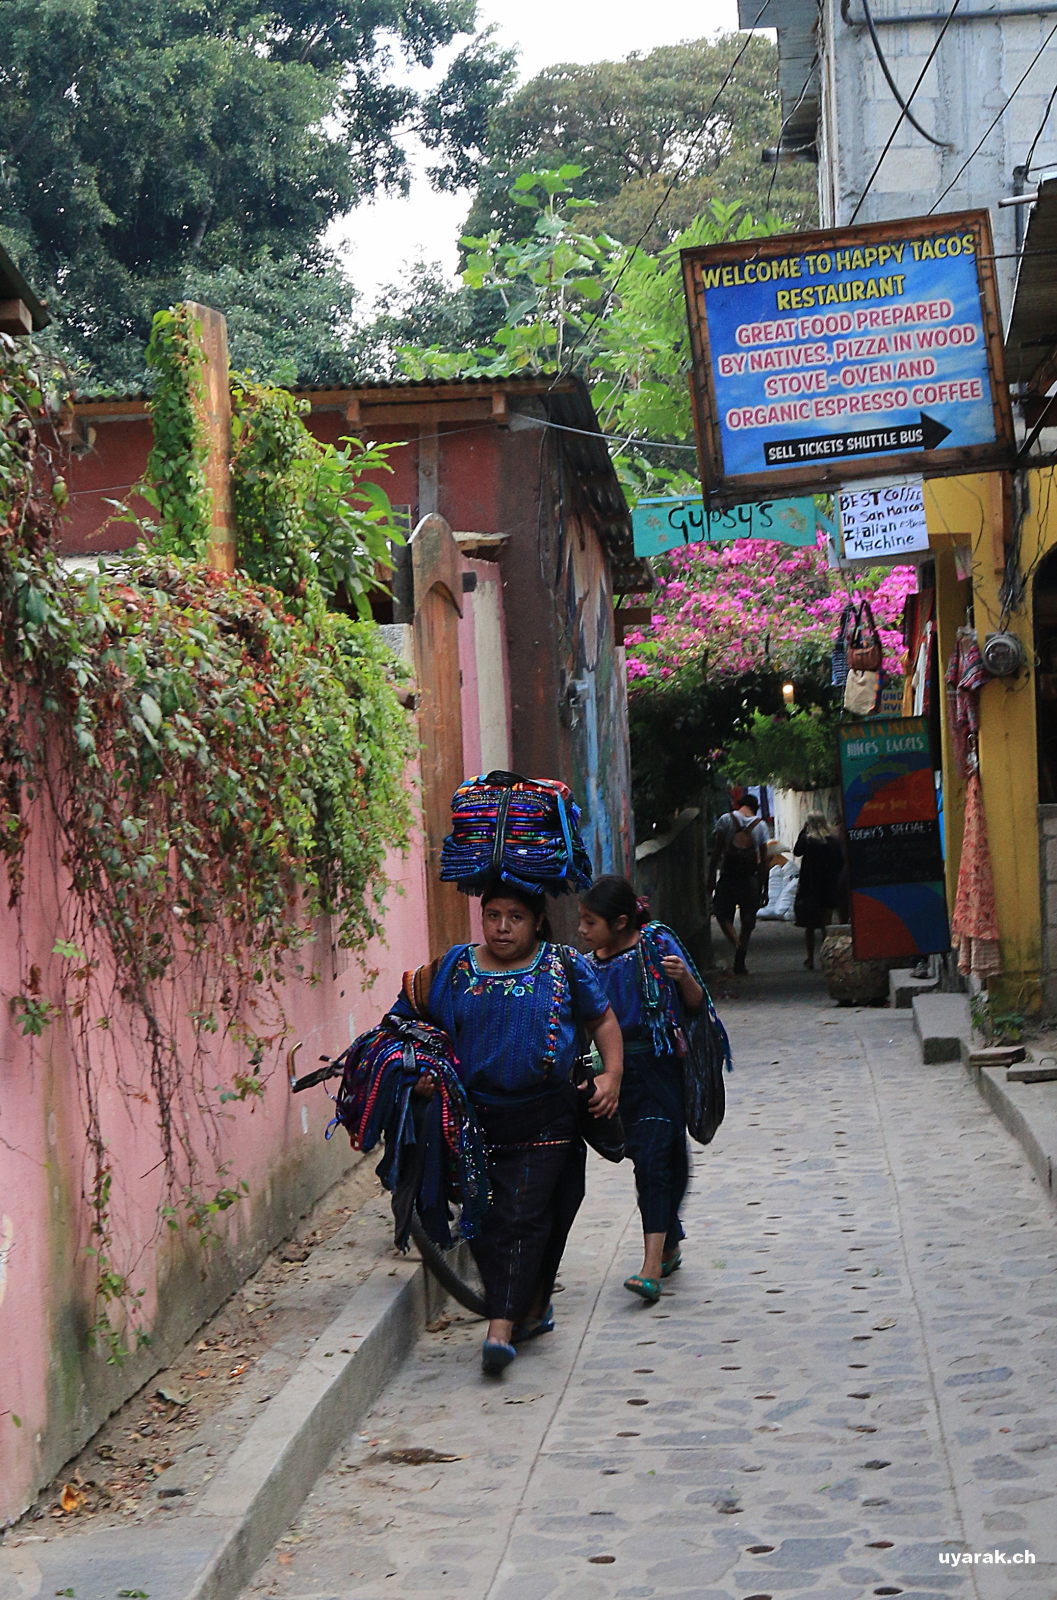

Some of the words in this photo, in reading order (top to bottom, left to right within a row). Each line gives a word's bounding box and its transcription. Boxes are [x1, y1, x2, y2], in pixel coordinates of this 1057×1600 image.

[701, 257, 802, 289] WELCOME
[805, 253, 832, 275] TO
[836, 243, 906, 272] HAPPY
[910, 234, 976, 261] TACOS
[776, 274, 906, 311] RESTAURANT
[737, 321, 795, 345] GREAT
[800, 314, 852, 337] FOOD
[856, 301, 952, 329] PREPARED
[720, 354, 746, 375] BY
[749, 345, 832, 371] NATIVES,
[834, 336, 889, 359] PIZZA
[893, 333, 912, 352] IN
[916, 326, 976, 349] WOOD
[766, 372, 826, 396] STOVE
[842, 364, 892, 386] OVEN
[897, 359, 935, 379] AND
[728, 402, 811, 428] ORGANIC
[814, 390, 908, 418] ESPRESSO
[912, 380, 982, 405] COFFEE
[768, 445, 796, 460] SELL
[798, 439, 844, 457] TICKETS
[847, 432, 897, 451] SHUTTLE
[900, 429, 924, 443] BUS
[838, 491, 882, 512] BEST
[860, 510, 885, 523] San
[886, 502, 925, 517] Marcos
[843, 522, 898, 542] Italian
[854, 535, 915, 553] Machine
